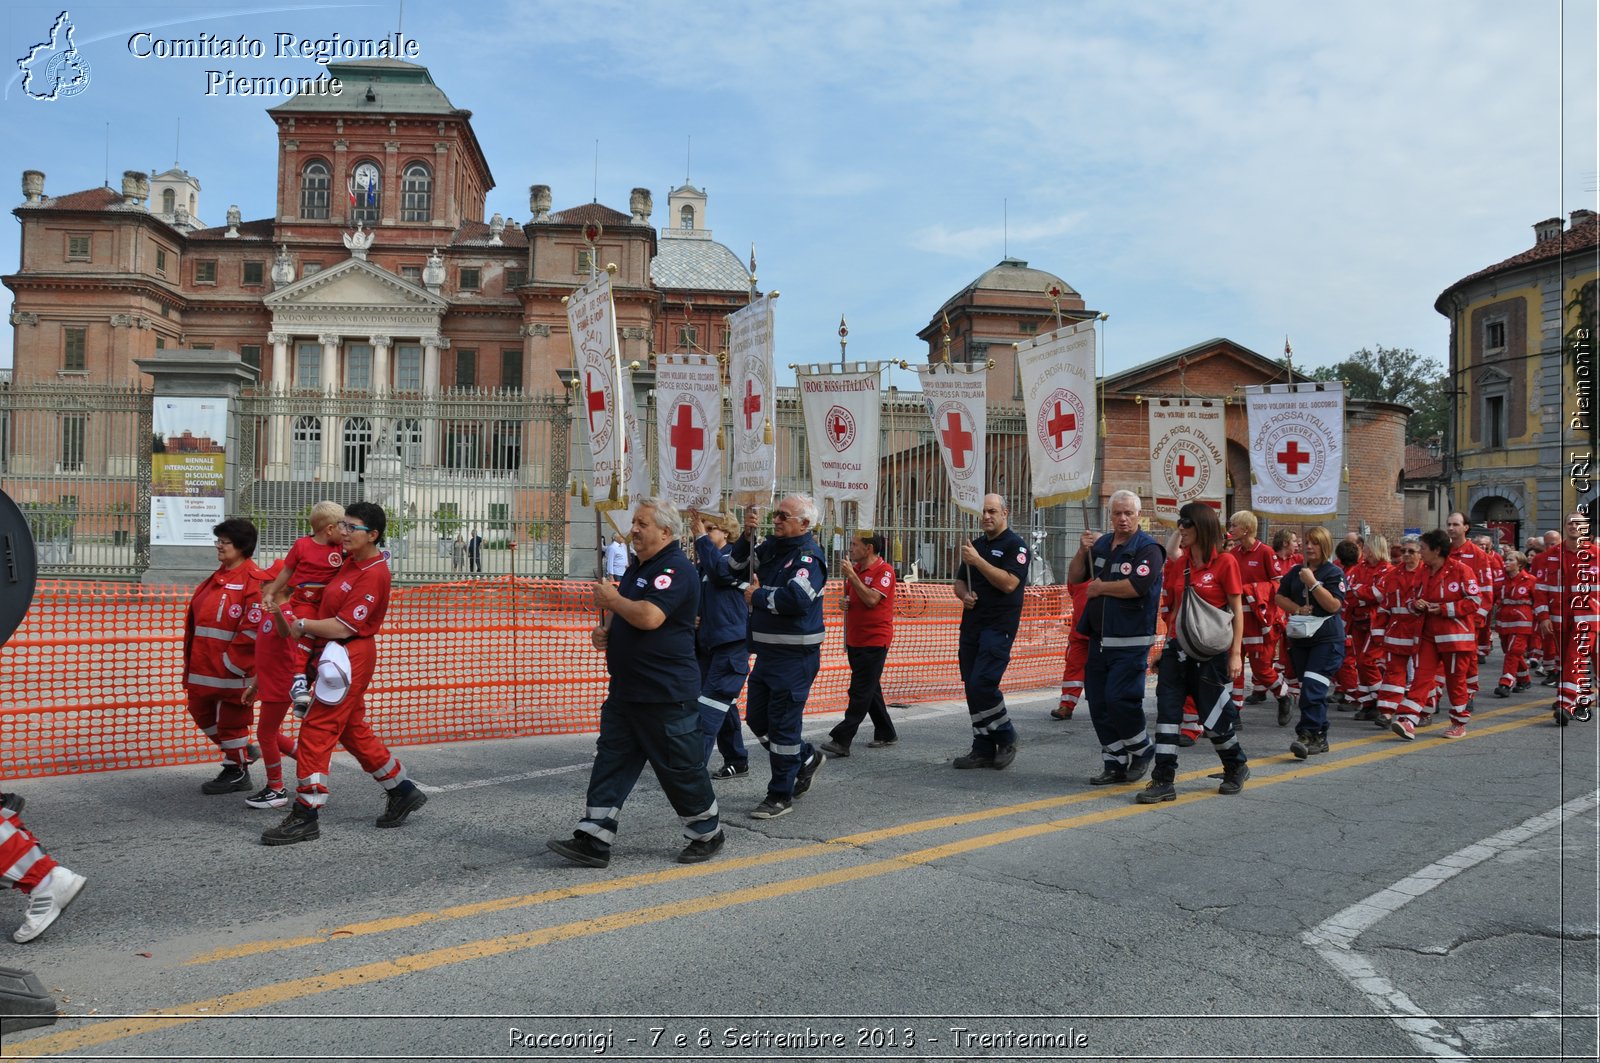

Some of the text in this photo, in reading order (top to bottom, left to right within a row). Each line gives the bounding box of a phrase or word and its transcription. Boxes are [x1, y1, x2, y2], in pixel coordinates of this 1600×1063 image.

[278, 313, 330, 322] LVDOVICVS
[940, 390, 960, 399] ROSSA
[1069, 394, 1078, 404] 22
[1269, 402, 1298, 411] VOLONTARI
[1299, 401, 1309, 410] DEL
[1310, 400, 1338, 410] SOCCORSO
[1187, 411, 1197, 419] DEL
[1253, 410, 1337, 452] CROCE ROSSA ITALIANA
[1151, 433, 1170, 461] CROCE
[1192, 428, 1224, 465] ITALIANA
[1199, 453, 1208, 464] 22
[1265, 425, 1324, 489] CONVENZIONE DI GINEVRA 22 AGOSTO 1864
[702, 487, 712, 495] DI
[847, 481, 869, 491] BOSCO
[1257, 495, 1334, 506] GRUPPO di MOROZZO
